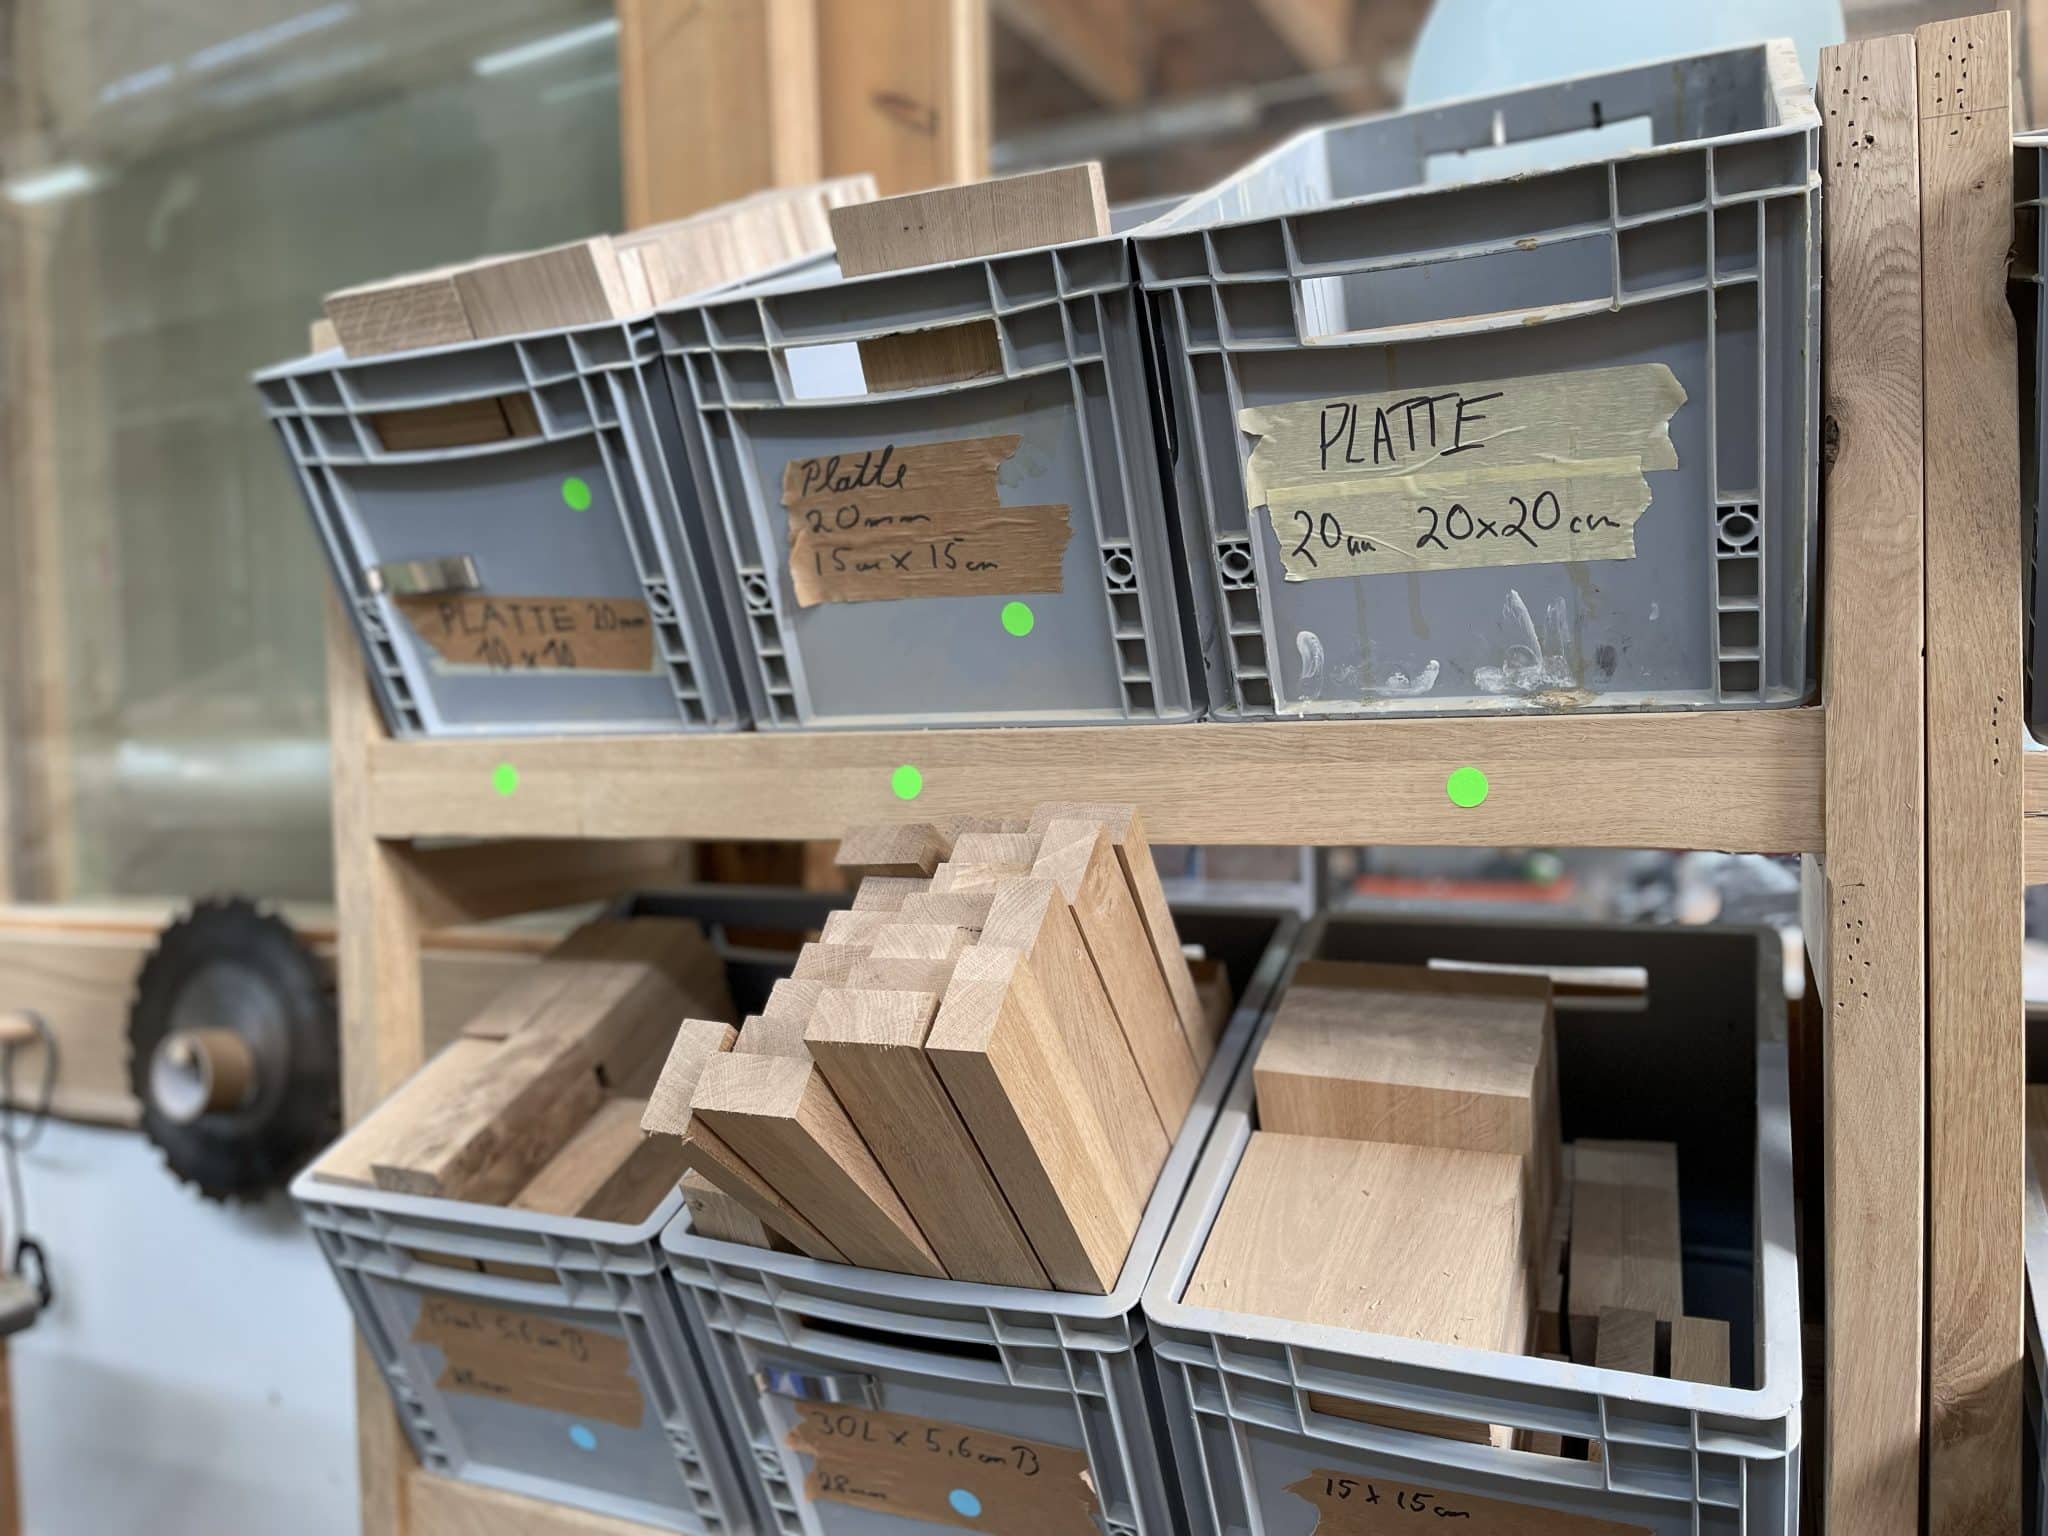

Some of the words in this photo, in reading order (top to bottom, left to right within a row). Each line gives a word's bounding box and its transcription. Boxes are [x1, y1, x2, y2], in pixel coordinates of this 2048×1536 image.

[1319, 391, 1504, 471] PLATTE
[801, 444, 908, 498] Platte
[805, 504, 932, 534] 20mm
[438, 602, 577, 637] PLATTE
[1325, 1477, 1361, 1500] 15
